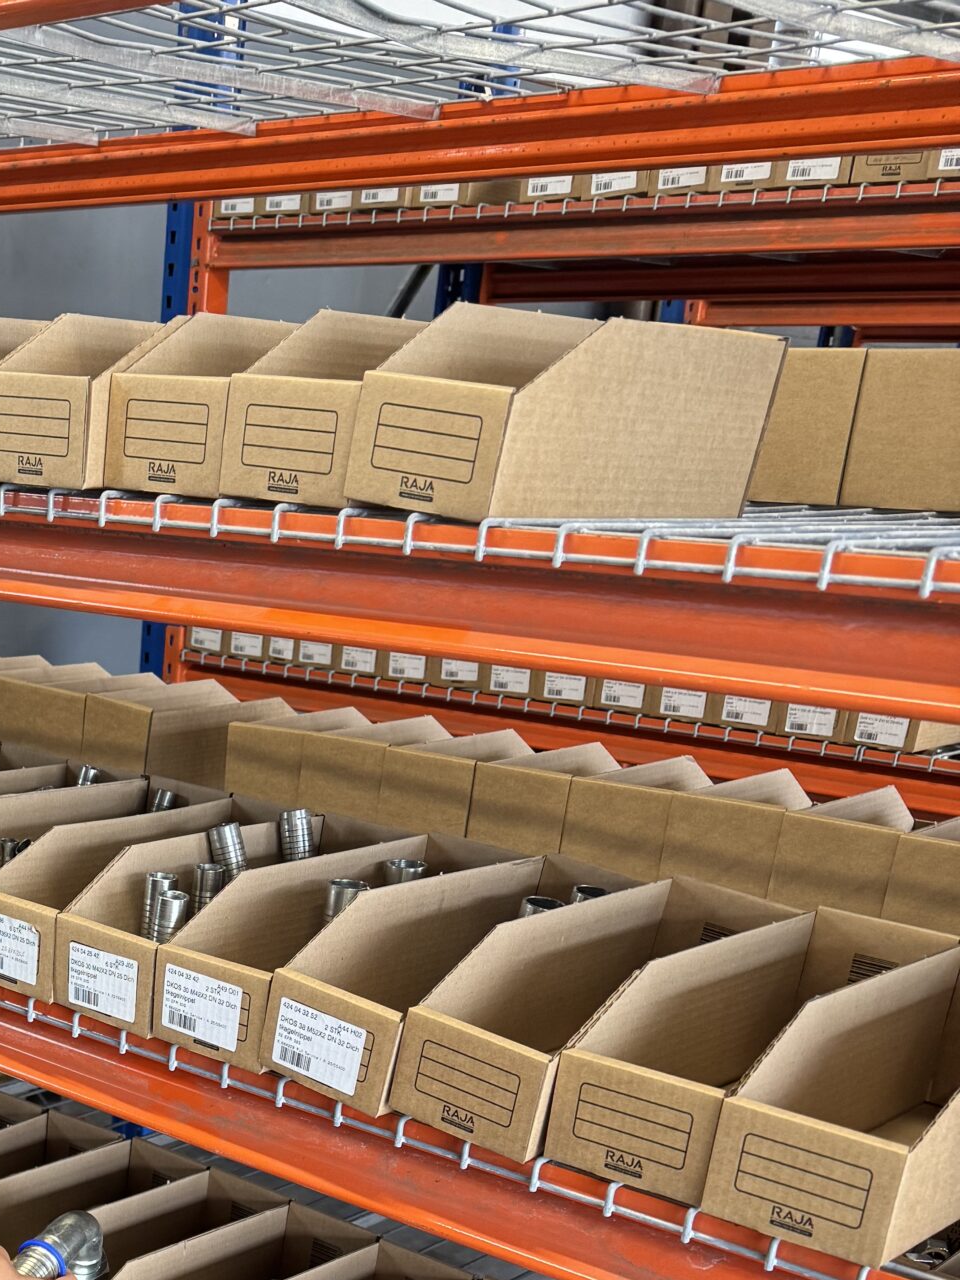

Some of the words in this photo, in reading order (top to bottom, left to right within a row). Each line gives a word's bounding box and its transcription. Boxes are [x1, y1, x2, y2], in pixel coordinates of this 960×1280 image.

[882, 165, 901, 173] RAJA
[17, 455, 43, 468] RAJA
[148, 461, 176, 476] RAJA
[268, 471, 300, 486] RAJA
[400, 475, 435, 492] RAJA
[167, 967, 176, 975] 424
[192, 975, 199, 983] 42
[166, 980, 181, 991] DKOS
[182, 985, 189, 993] 30
[190, 988, 207, 1000] M42X2
[208, 994, 217, 1003] DN
[217, 997, 224, 1005] 32
[225, 1000, 237, 1010] Dich
[282, 1001, 293, 1010] 424
[293, 1005, 301, 1013] 04
[301, 1008, 309, 1017] 32
[310, 1012, 317, 1020] 52
[280, 1014, 297, 1027] DKOS
[298, 1022, 305, 1031] 38
[306, 1025, 326, 1039] M52X2
[327, 1033, 336, 1043] DN
[337, 1038, 345, 1047] 32
[345, 1041, 360, 1053] Dich
[442, 1104, 475, 1127] RAJA
[605, 1149, 643, 1172] RAJA
[771, 1205, 814, 1230] RAJA
